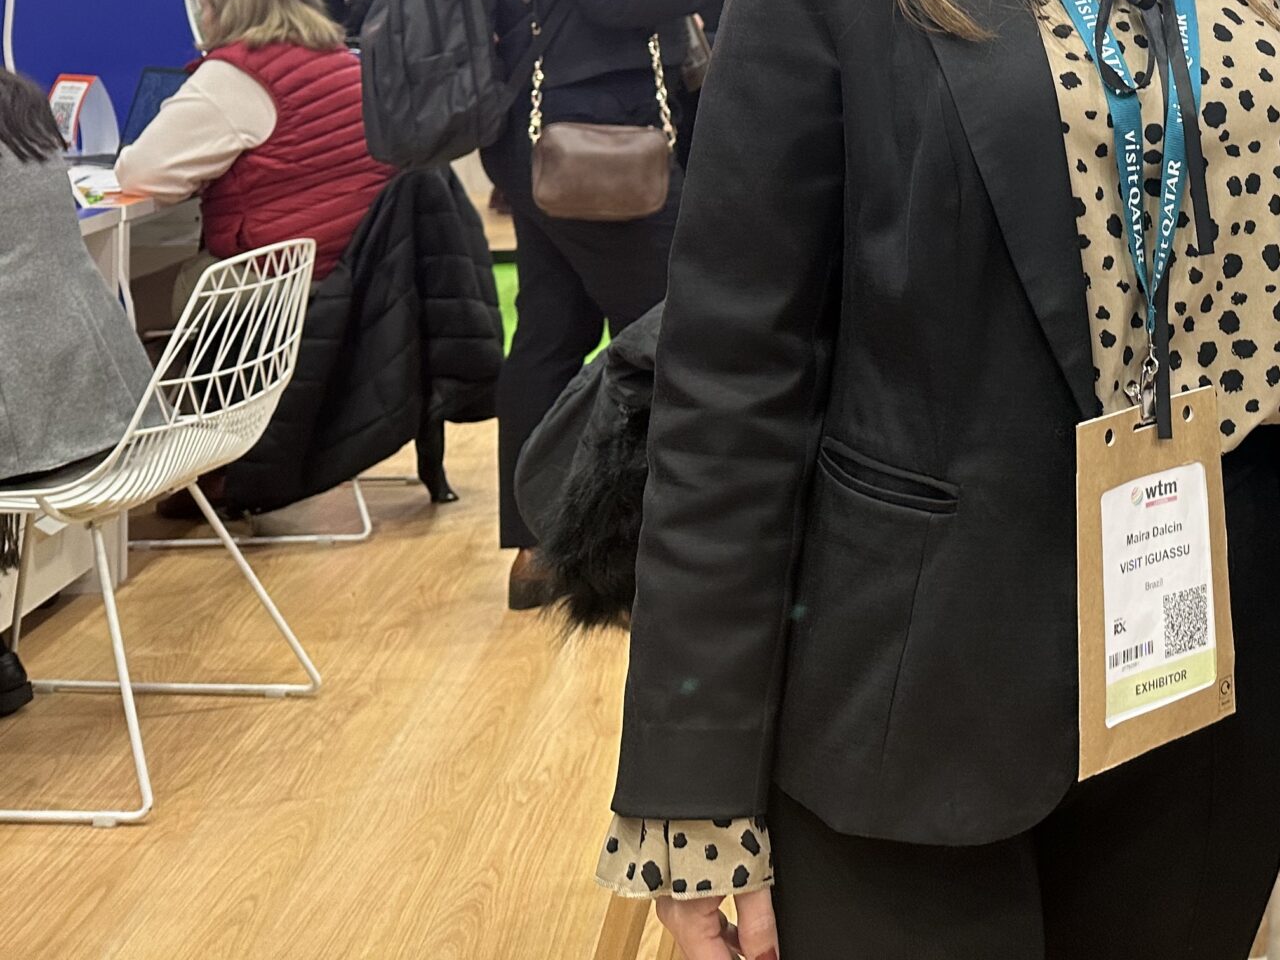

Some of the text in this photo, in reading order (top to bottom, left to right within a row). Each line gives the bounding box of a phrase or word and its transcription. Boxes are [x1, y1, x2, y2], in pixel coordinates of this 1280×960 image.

[1145, 480, 1177, 499] wtm
[1152, 521, 1183, 538] Dalcin
[1120, 544, 1190, 574] VISIT IGUASSU
[1144, 578, 1163, 591] Brazil
[1135, 669, 1187, 696] EXHIBITOR
